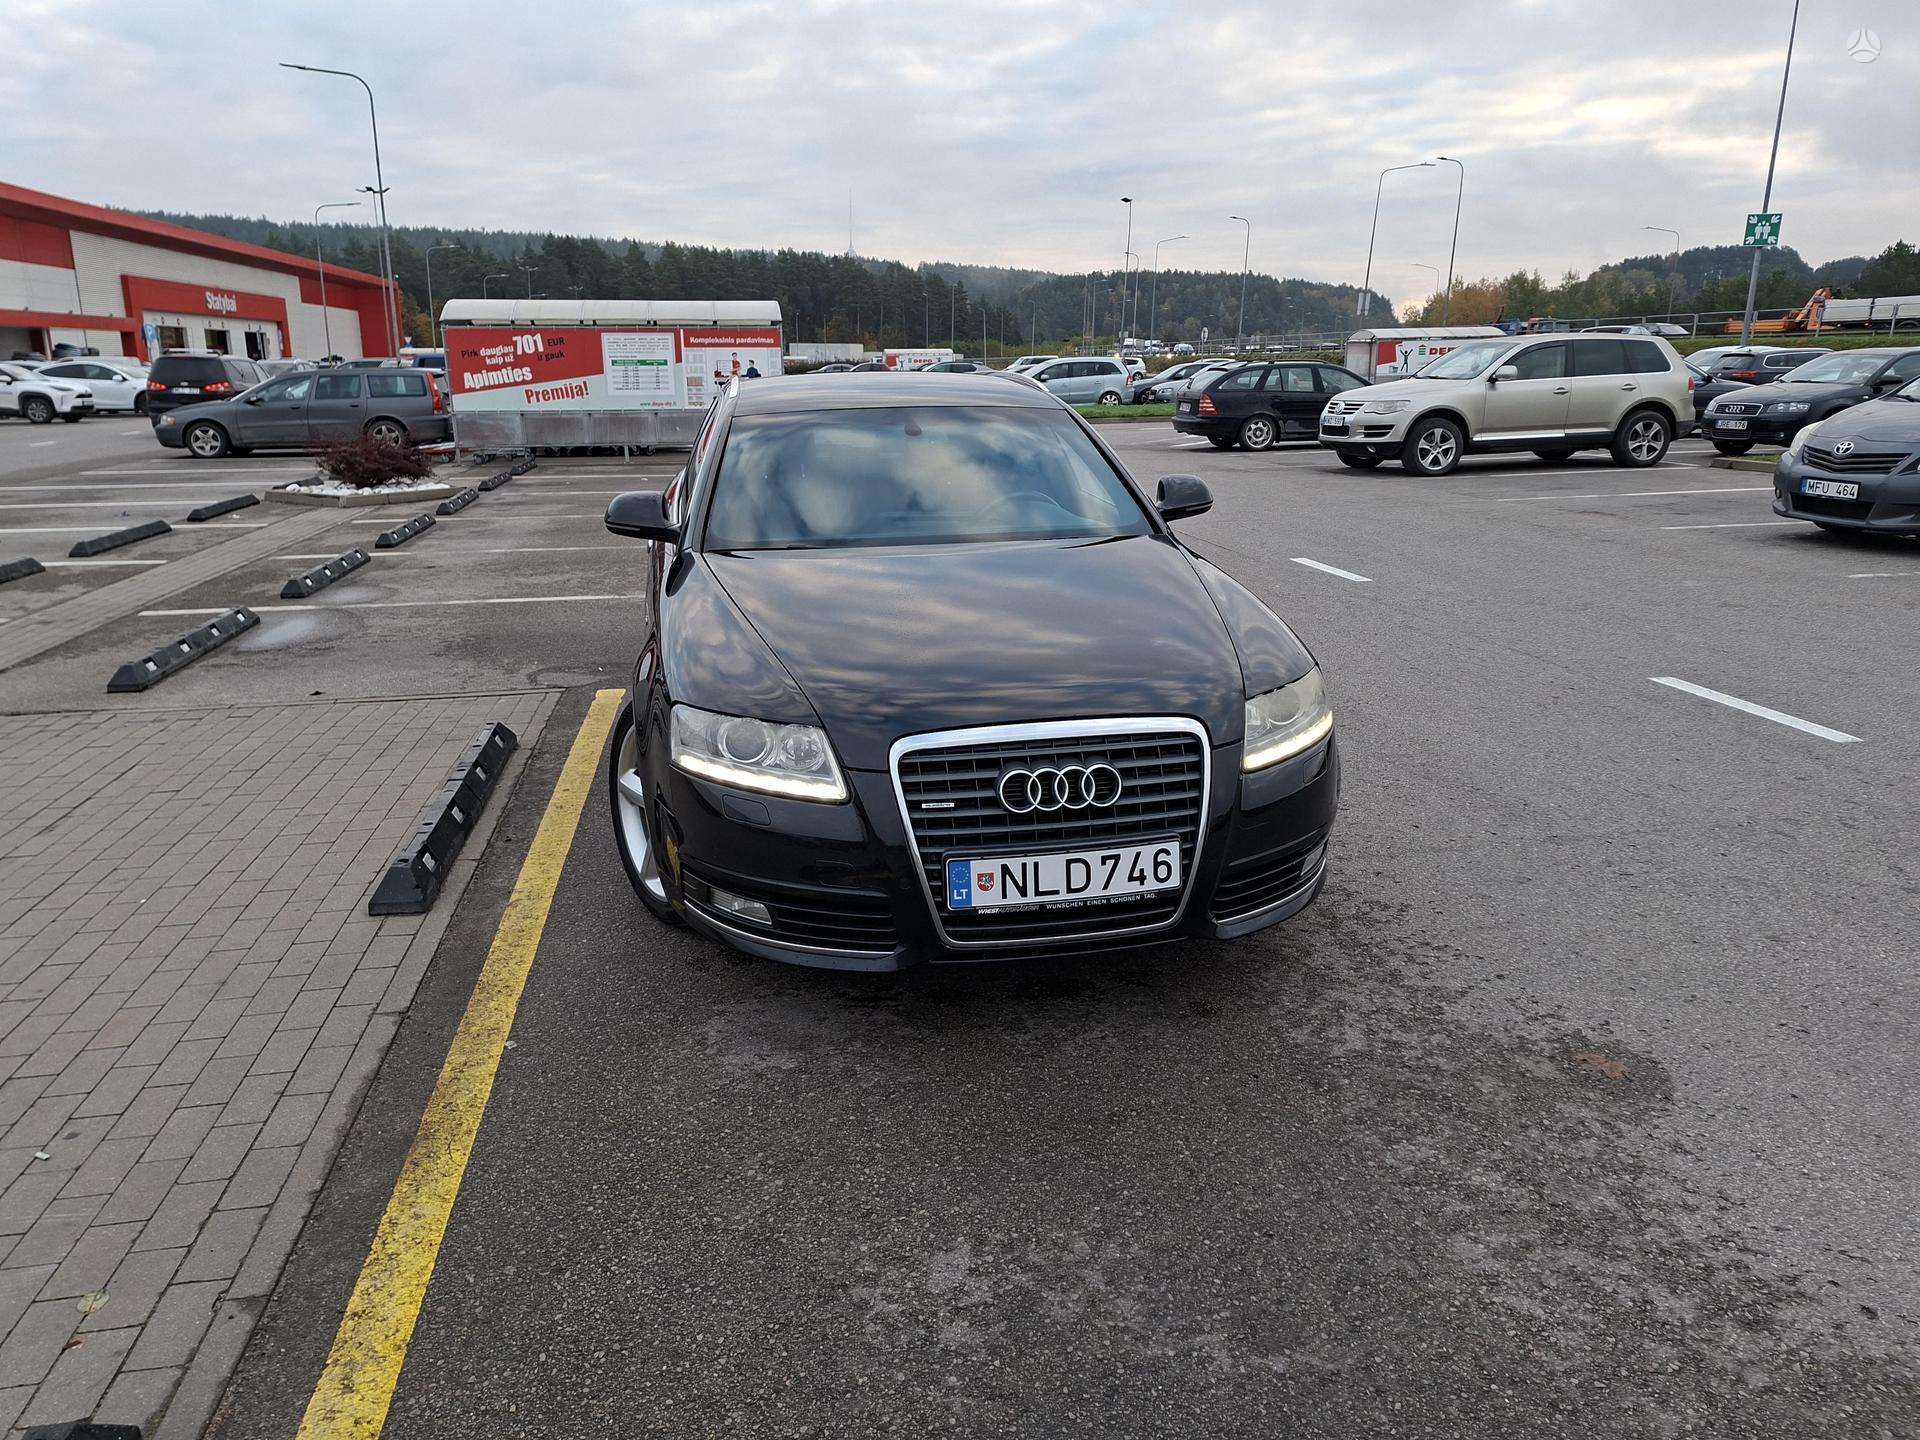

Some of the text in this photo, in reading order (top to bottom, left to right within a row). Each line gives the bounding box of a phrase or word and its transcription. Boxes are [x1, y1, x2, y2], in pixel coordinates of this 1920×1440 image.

[205, 291, 237, 314] Statybai
[461, 333, 566, 358] Pirk daugiau 701 EUR
[690, 336, 775, 345] Kompleksinis pardavimas
[485, 356, 503, 366] kaip
[545, 350, 566, 362] gauk
[463, 366, 533, 389] Apimties
[1807, 482, 1830, 494] MFU
[1836, 484, 1855, 497] 464
[953, 889, 967, 900] LT
